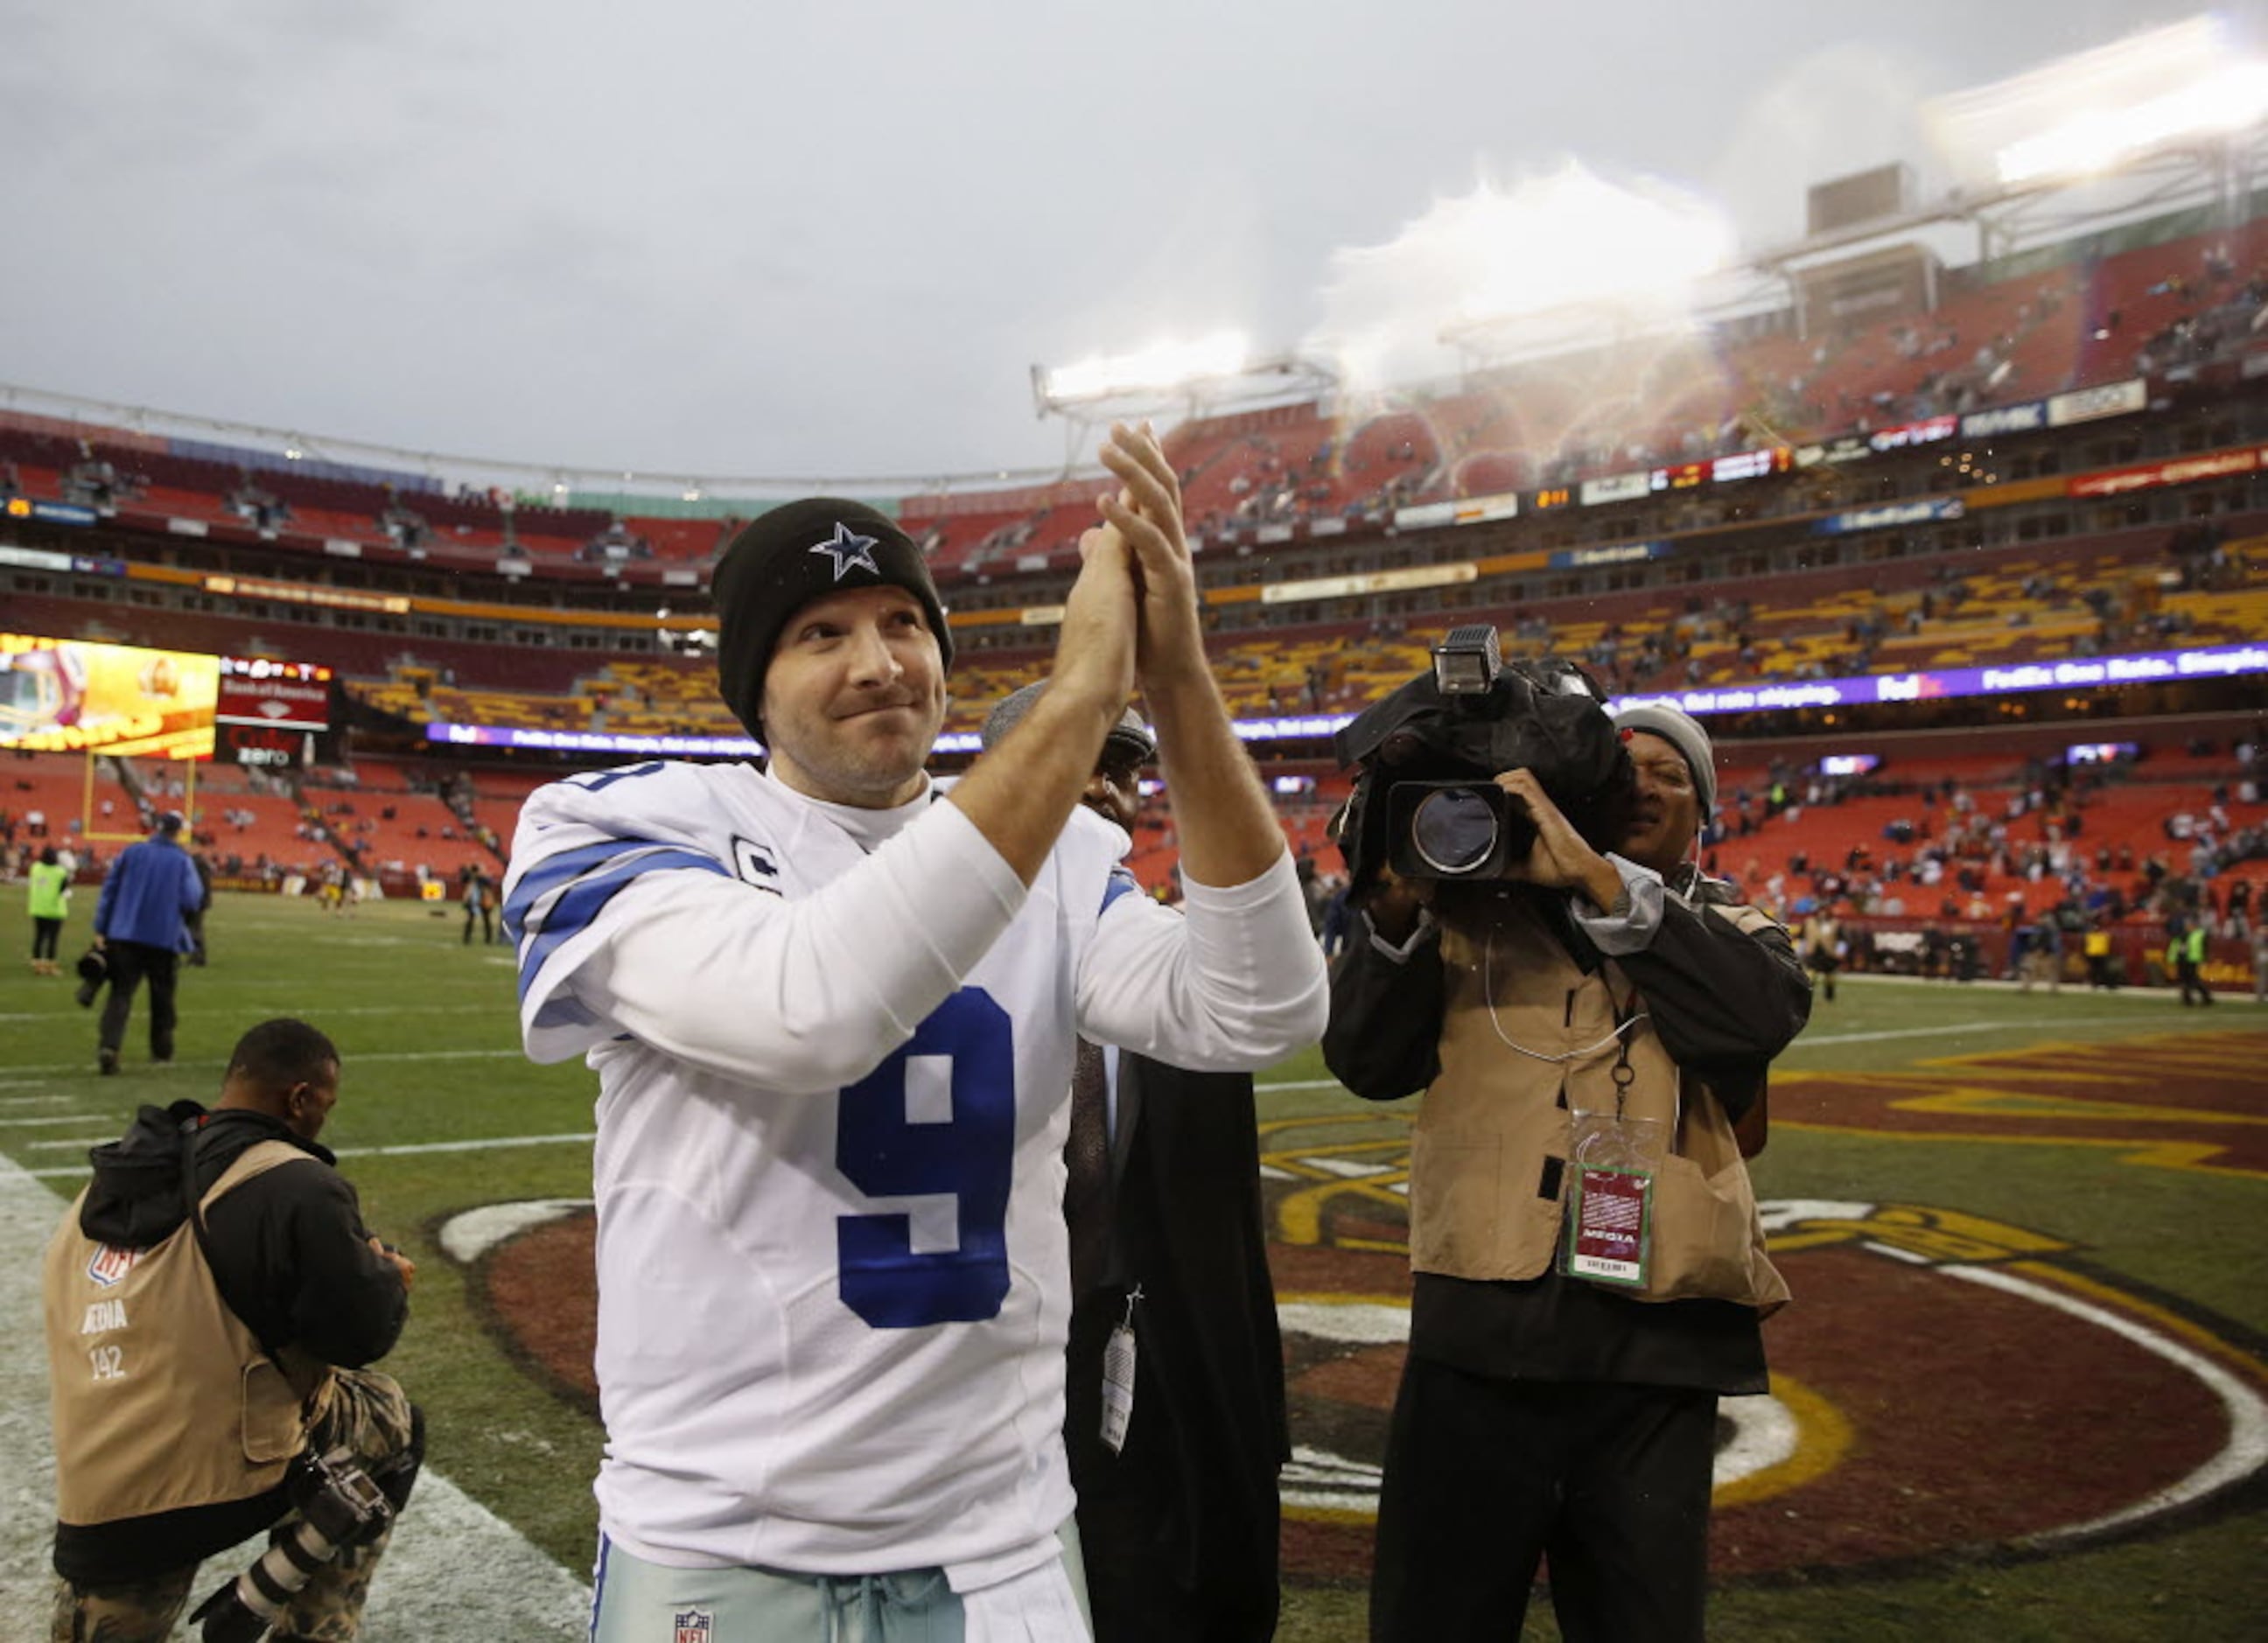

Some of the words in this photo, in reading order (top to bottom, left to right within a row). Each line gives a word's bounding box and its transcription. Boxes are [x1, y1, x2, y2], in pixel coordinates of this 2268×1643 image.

[2054, 662, 2104, 683] One
[238, 747, 290, 766] zero
[836, 986, 1016, 1330] 9
[1582, 1227, 1635, 1244] MEDIA
[90, 1345, 126, 1381] 142
